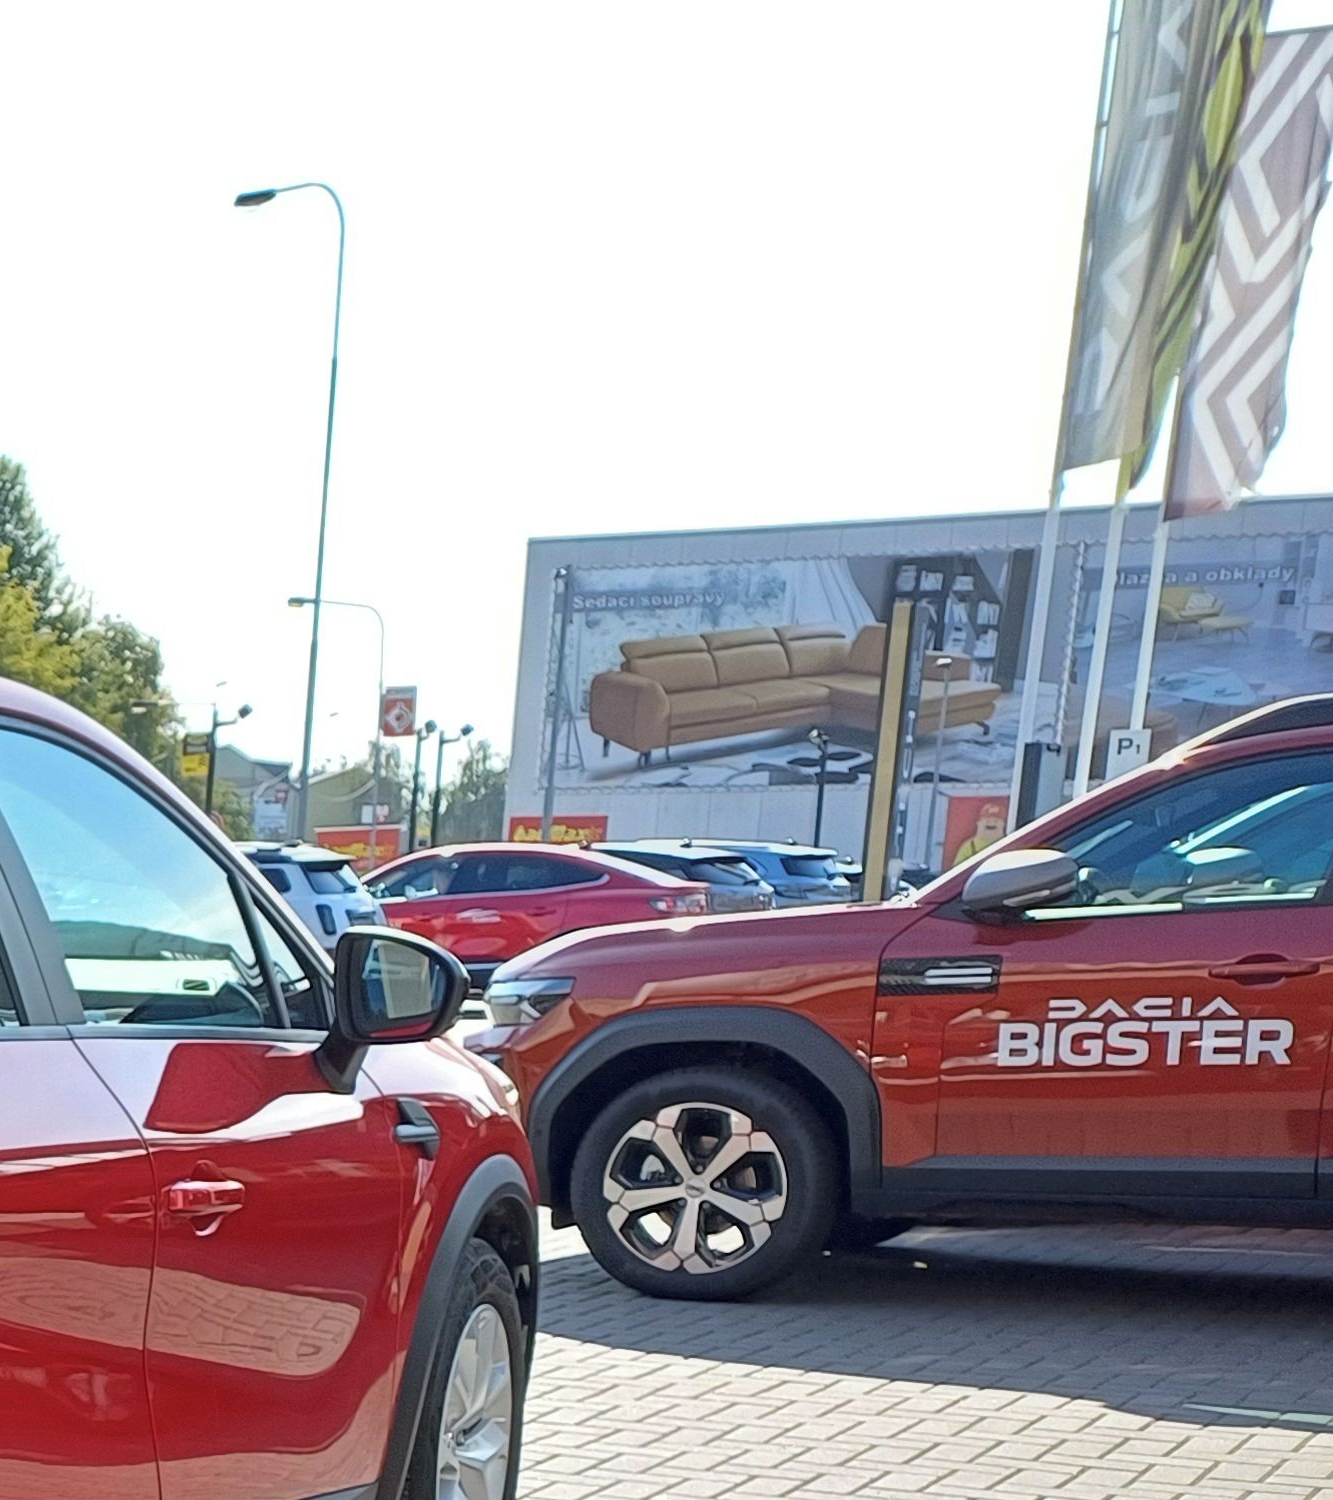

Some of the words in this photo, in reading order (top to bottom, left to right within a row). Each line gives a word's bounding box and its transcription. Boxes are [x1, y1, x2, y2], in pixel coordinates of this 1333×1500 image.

[1185, 572, 1198, 582] a
[1205, 565, 1295, 582] obklady
[1048, 996, 1239, 1019] DACIA
[997, 1019, 1294, 1067] BIGSTER
